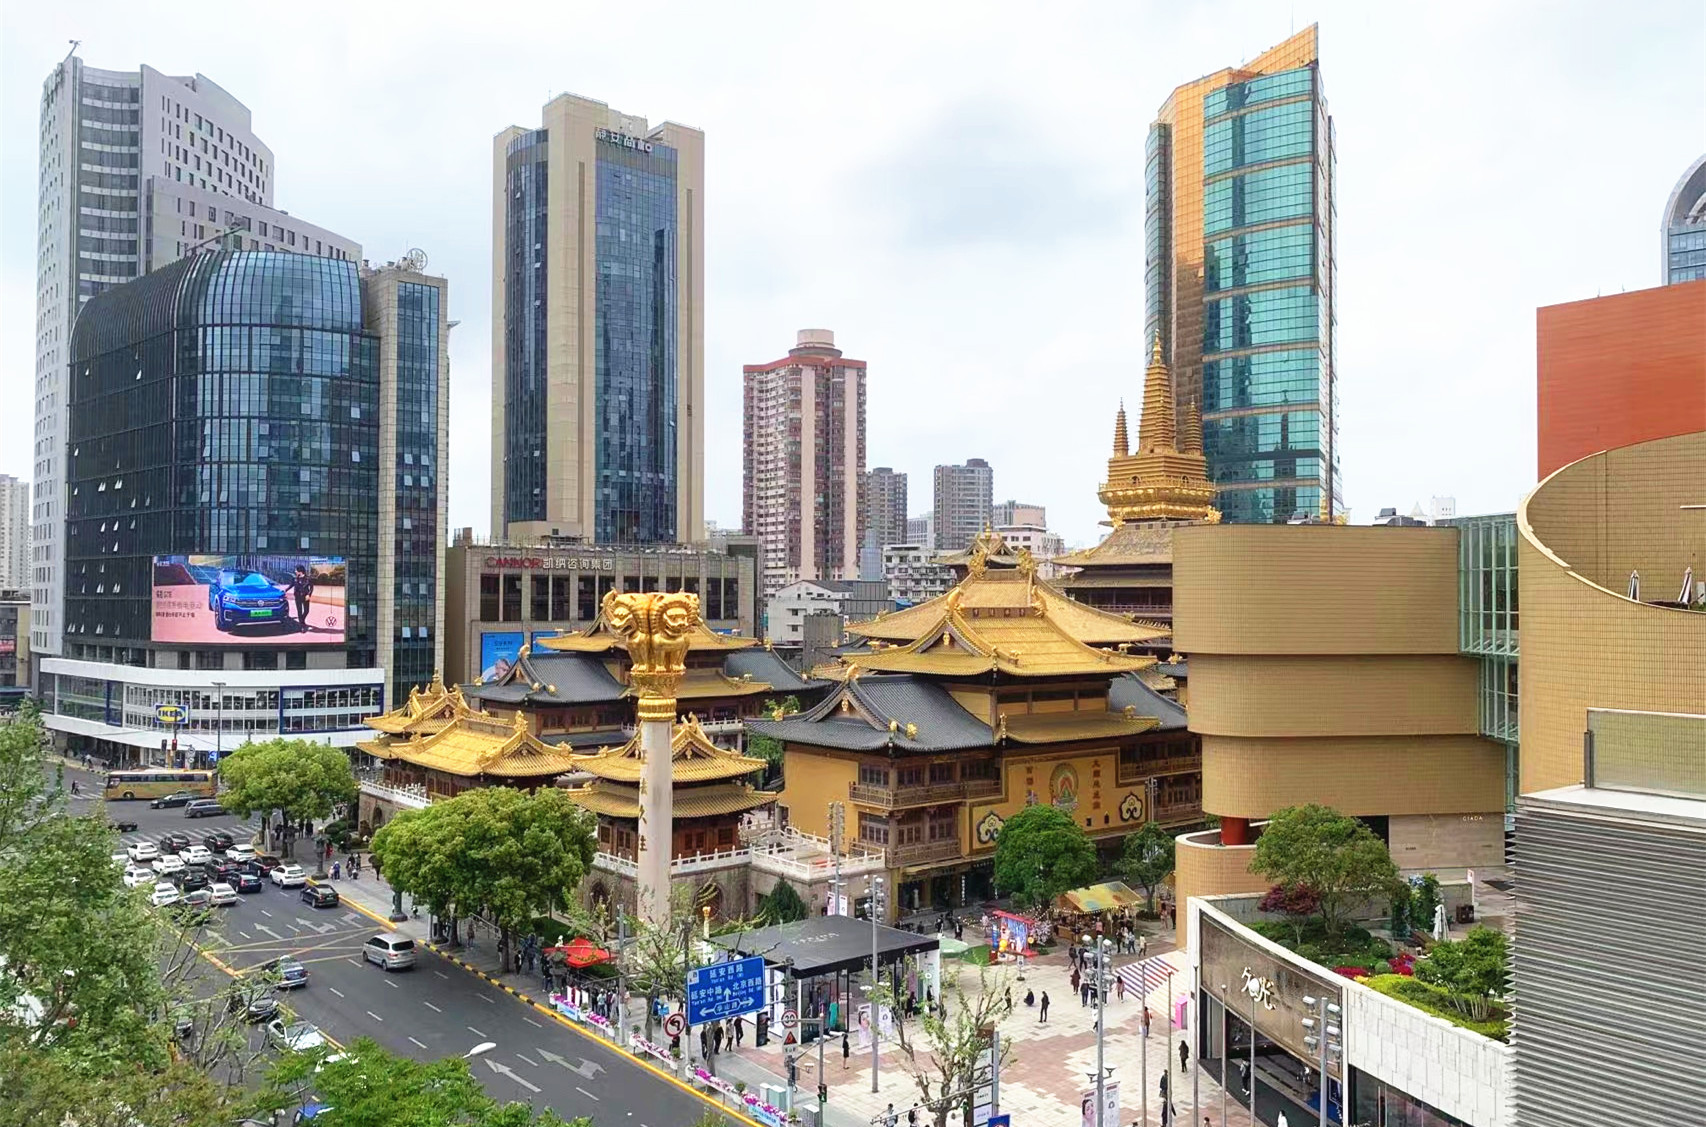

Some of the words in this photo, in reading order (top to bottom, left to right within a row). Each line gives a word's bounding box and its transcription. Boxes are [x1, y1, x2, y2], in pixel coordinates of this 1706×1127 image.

[543, 557, 613, 571] 凯纳咨询集团
[158, 710, 183, 718] IKEA
[710, 964, 743, 978] 延安西路
[732, 977, 762, 990] 北京西路
[691, 986, 722, 1000] 延安中路
